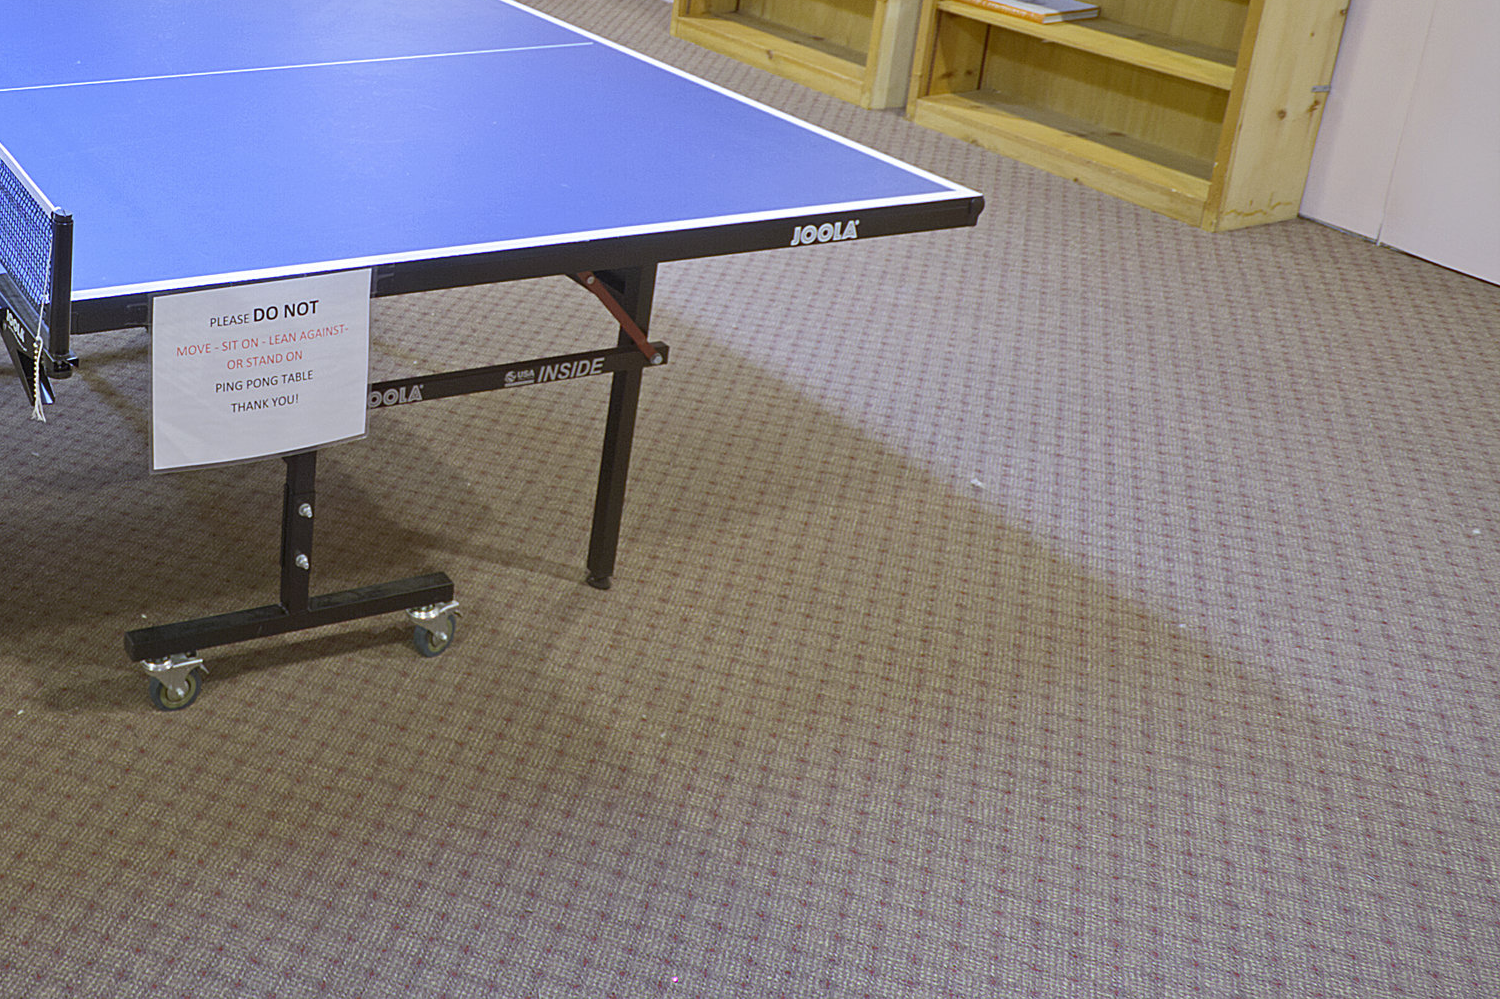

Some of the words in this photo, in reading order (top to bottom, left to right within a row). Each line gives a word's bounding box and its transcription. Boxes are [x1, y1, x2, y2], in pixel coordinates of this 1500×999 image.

[790, 220, 860, 246] JOOLA
[210, 313, 250, 327] PLEASE
[253, 306, 278, 322] DO
[284, 300, 319, 318] NOT
[176, 344, 211, 356] MOVE
[222, 340, 238, 351] SIT
[241, 338, 259, 349] ON
[269, 333, 296, 345] LEAN
[227, 359, 243, 369] OR
[246, 353, 283, 368] STAND
[286, 351, 303, 362] ON
[517, 369, 535, 379] USA
[537, 357, 605, 383] INSIDE
[215, 381, 243, 393] PING
[246, 376, 279, 389] PONG
[281, 370, 313, 384] TABLE
[231, 400, 269, 413] THANK
[271, 394, 299, 407] YOU!
[367, 385, 424, 408] OOLA
